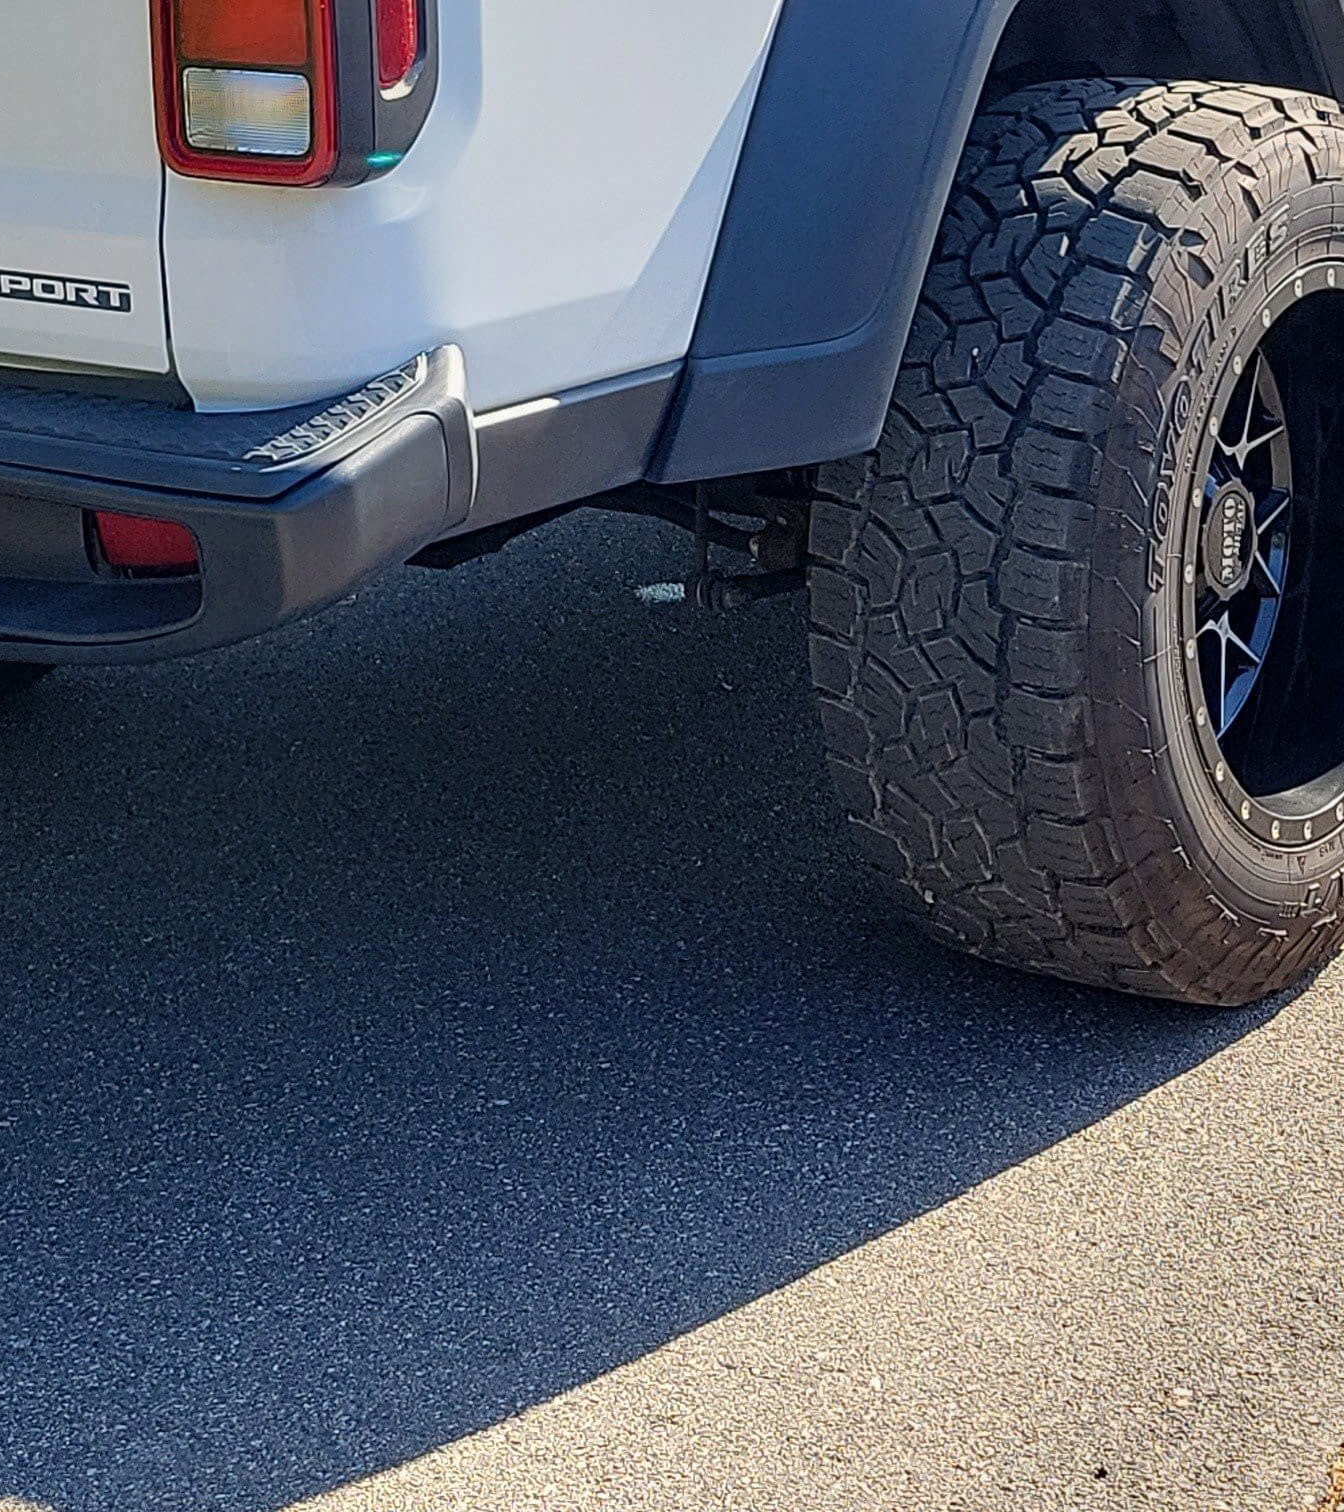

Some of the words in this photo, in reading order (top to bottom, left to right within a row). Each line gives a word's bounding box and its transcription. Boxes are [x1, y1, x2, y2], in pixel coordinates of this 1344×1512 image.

[1147, 376, 1192, 593] TOYO
[1190, 202, 1290, 377] TIRES
[1220, 497, 1236, 581] MOTO
